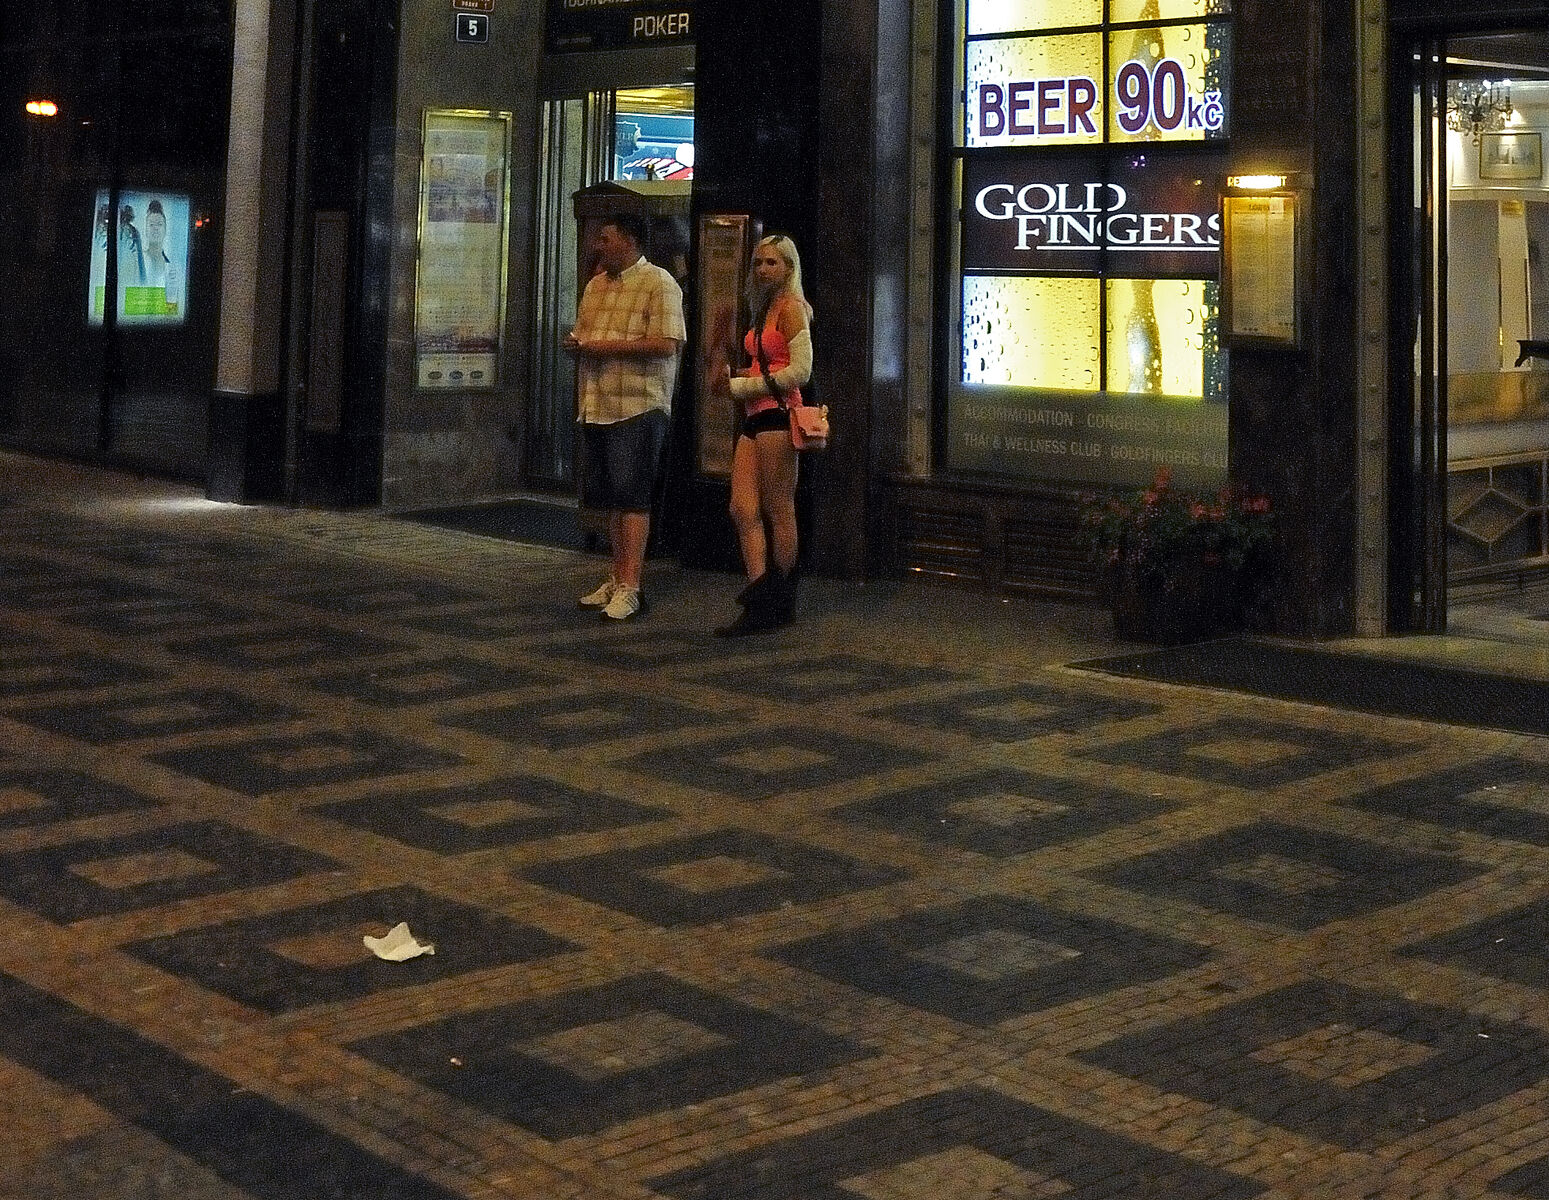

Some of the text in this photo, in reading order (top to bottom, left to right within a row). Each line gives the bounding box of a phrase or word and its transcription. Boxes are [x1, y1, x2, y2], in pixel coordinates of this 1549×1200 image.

[468, 19, 478, 36] 5
[633, 13, 690, 38] POKER
[977, 77, 1099, 137] BEER
[975, 183, 1127, 220] GOLD
[1004, 436, 1067, 455] WELLNESS
[1070, 441, 1101, 458] CLUB
